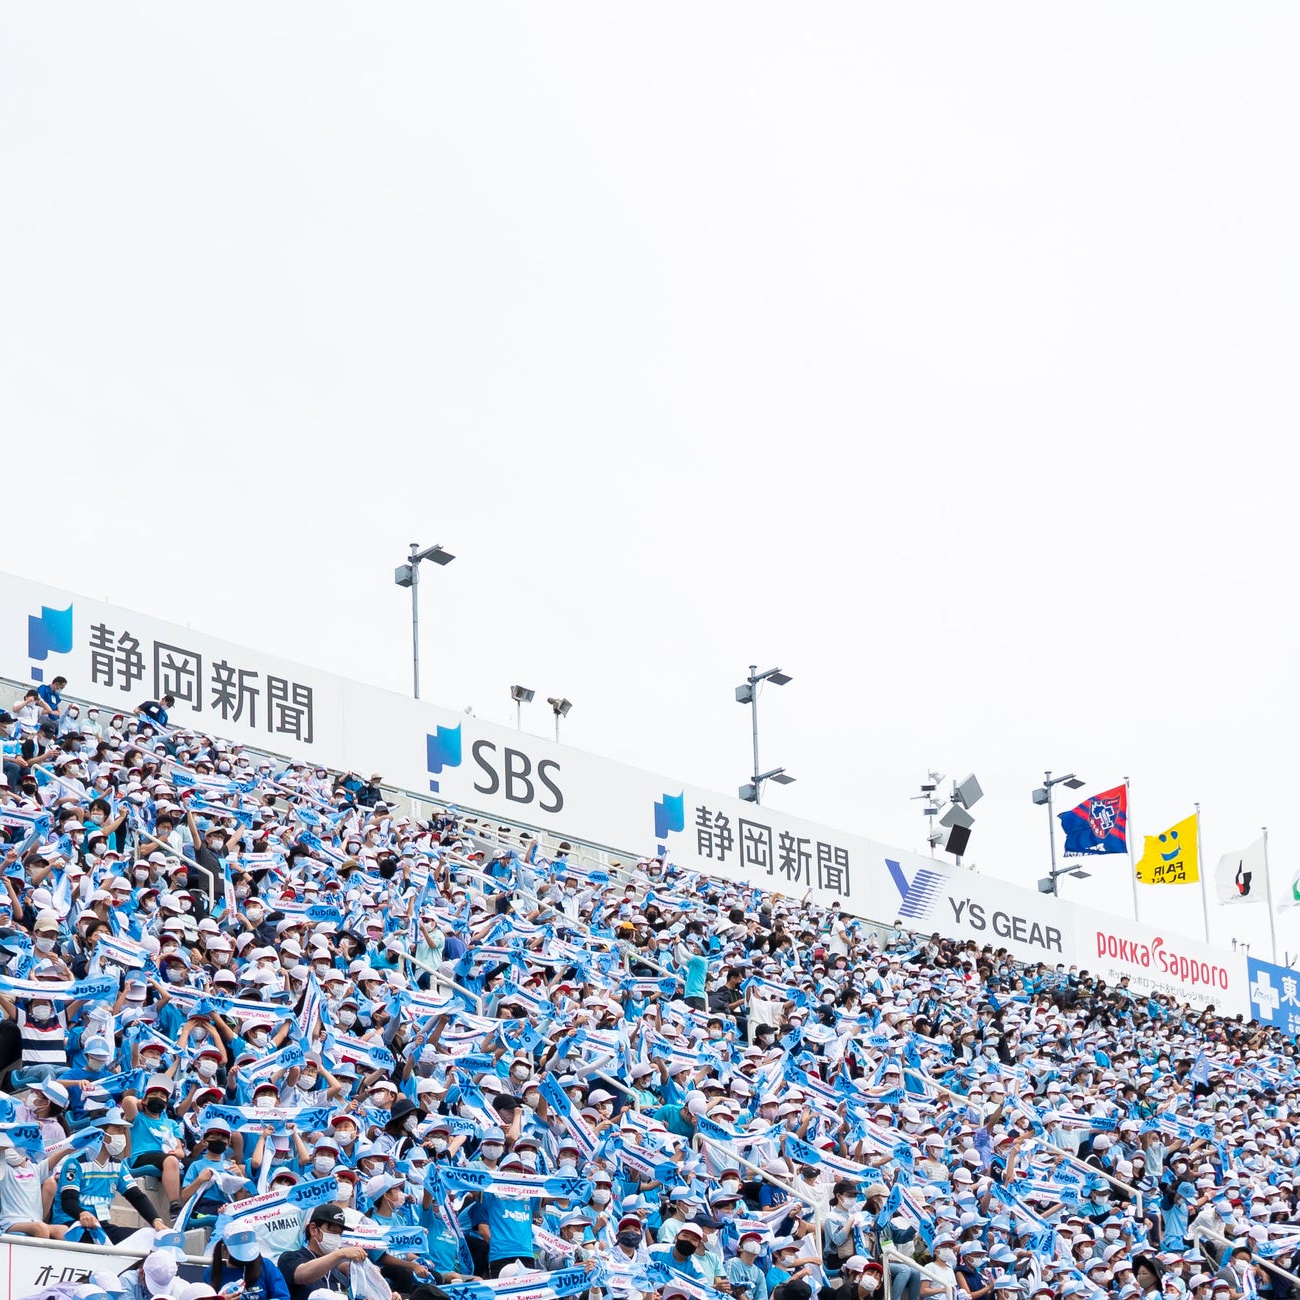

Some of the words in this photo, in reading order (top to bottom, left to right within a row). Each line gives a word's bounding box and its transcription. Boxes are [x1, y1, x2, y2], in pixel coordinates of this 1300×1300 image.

[89, 623, 314, 744] 静岡新聞
[471, 740, 565, 813] SBS
[695, 806, 850, 897] 静岡新聞
[309, 906, 338, 918] Júbilo
[948, 897, 986, 931] Y'S
[992, 913, 1063, 953] GEAR
[73, 982, 111, 996] Júbilo
[295, 1181, 337, 1200] Júbilo
[265, 1217, 299, 1233] YAMAH
[389, 1235, 423, 1247] Júbilo
